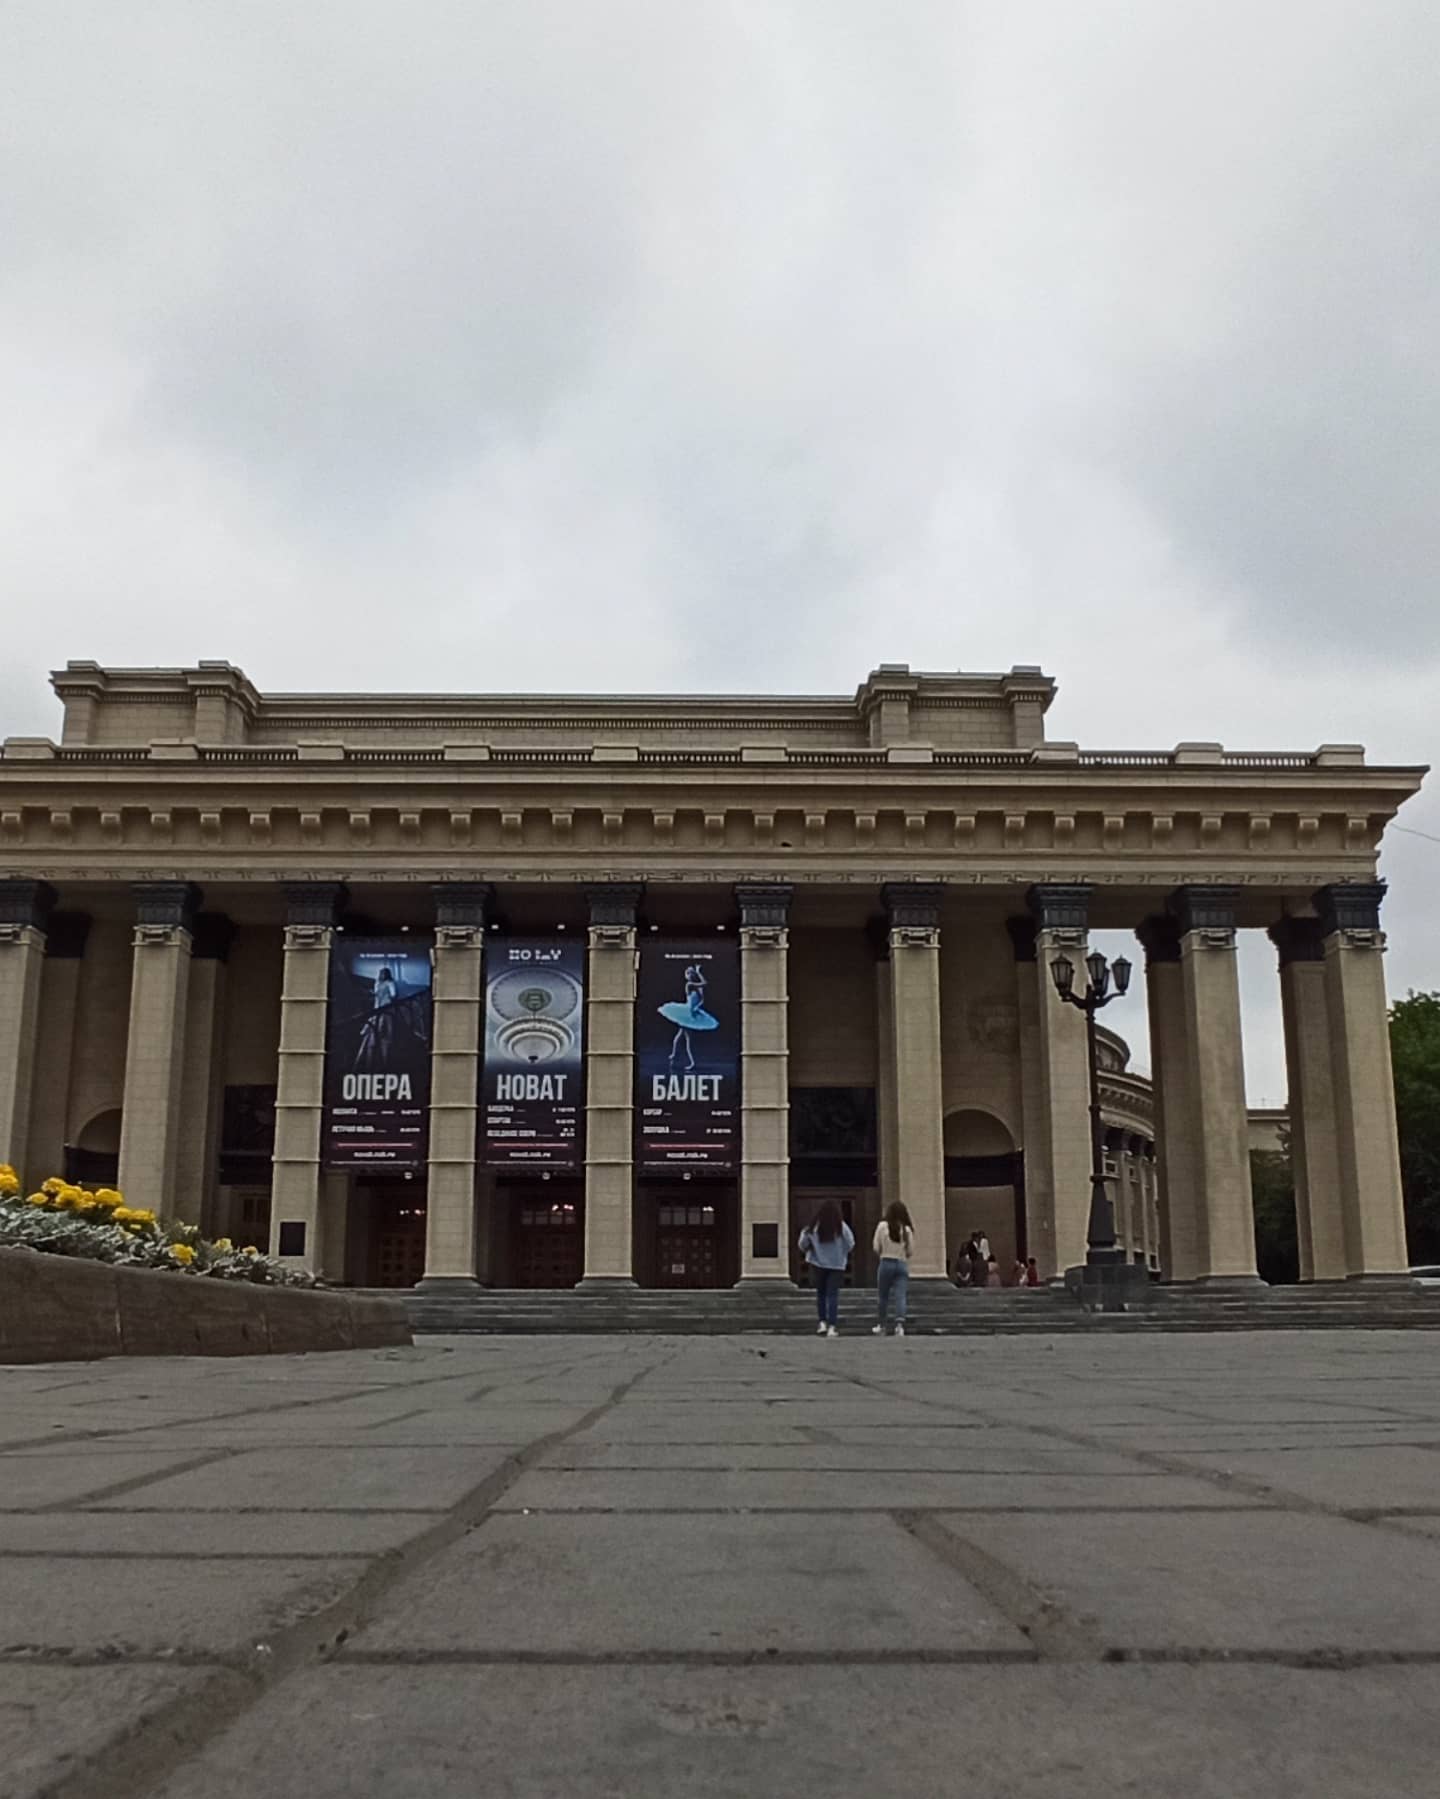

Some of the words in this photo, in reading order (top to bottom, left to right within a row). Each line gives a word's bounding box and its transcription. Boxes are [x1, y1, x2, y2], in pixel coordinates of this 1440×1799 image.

[342, 1073, 412, 1100] ОПЕРА
[496, 1073, 567, 1101] НОВАТ
[652, 1074, 723, 1101] БАЛЕТ
